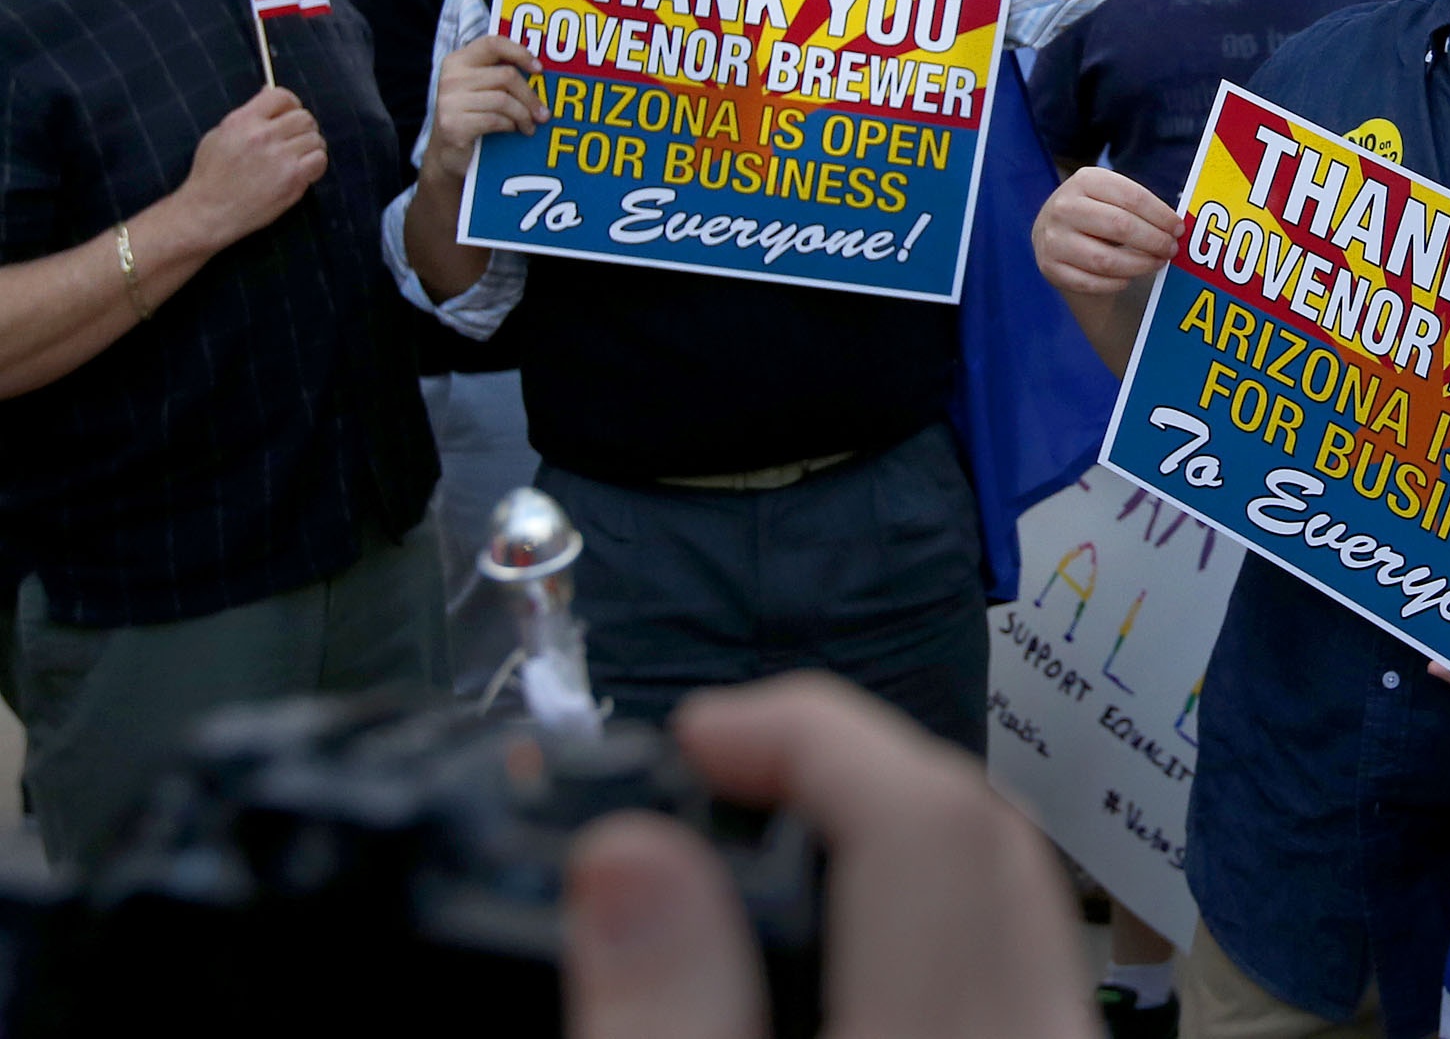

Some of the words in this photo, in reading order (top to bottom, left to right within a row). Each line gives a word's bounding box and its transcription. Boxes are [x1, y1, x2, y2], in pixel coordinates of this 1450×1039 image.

[509, 3, 751, 88] GOVENOR
[766, 42, 978, 120] BREWER
[545, 127, 649, 180] FOR
[663, 143, 909, 214] BUSINESS
[758, 104, 805, 150] IS
[821, 114, 952, 170] OPEN
[1379, 139, 1392, 151] on
[500, 174, 583, 232] To
[608, 186, 932, 265] Everyone!
[1186, 199, 1442, 380] GOVENOR
[1178, 288, 1411, 448] ARIZONA
[1198, 364, 1305, 457] FOR
[1148, 405, 1227, 489] To
[998, 611, 1094, 703] SUPPORT
[1098, 704, 1196, 782] EQUALIT
